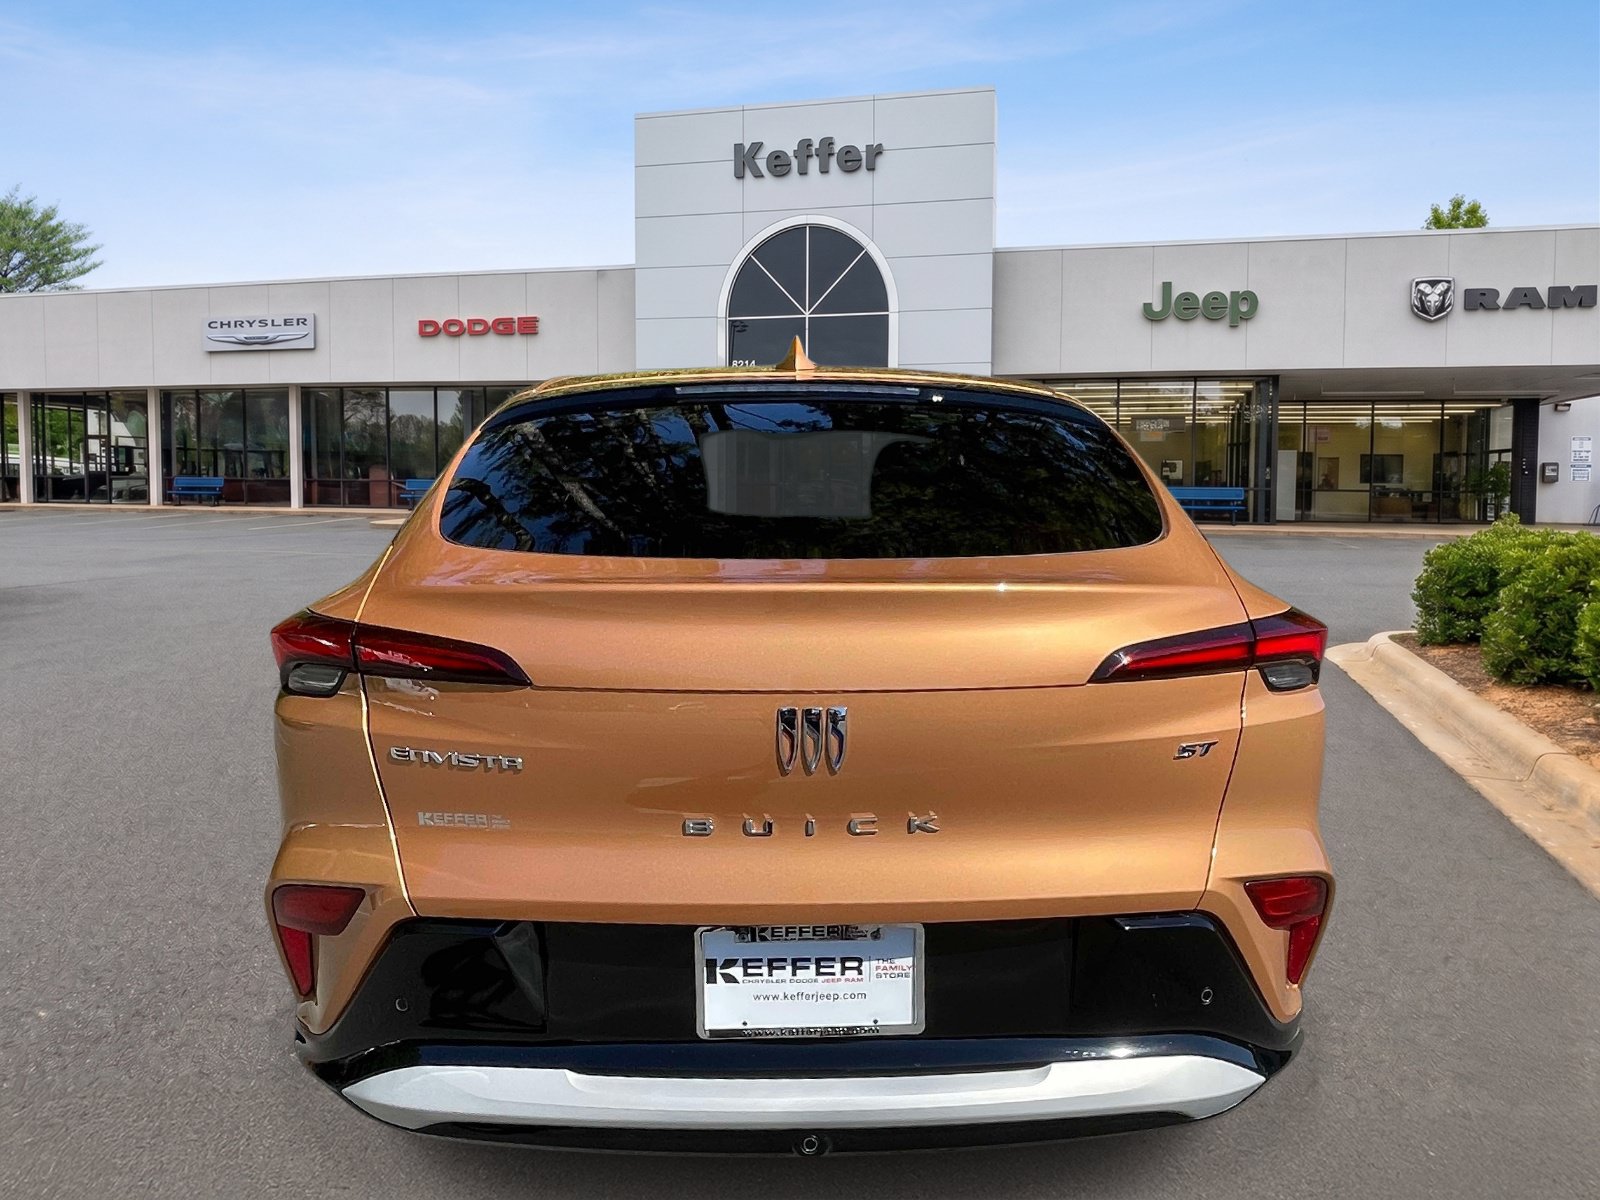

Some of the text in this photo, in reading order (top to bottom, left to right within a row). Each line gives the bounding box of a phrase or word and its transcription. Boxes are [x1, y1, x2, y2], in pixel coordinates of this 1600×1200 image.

[733, 136, 883, 179] Keffer
[1143, 281, 1259, 328] Jeep
[1464, 285, 1598, 311] RAM
[207, 317, 308, 329] CHRYSLER
[418, 316, 539, 337] DODGE
[1173, 740, 1218, 760] ST
[418, 811, 488, 827] KEFFER
[682, 813, 940, 837] BUICK
[750, 925, 840, 942] KEFFER
[706, 957, 864, 985] KEFFER
[752, 991, 867, 1002] www.kefferjeep.com
